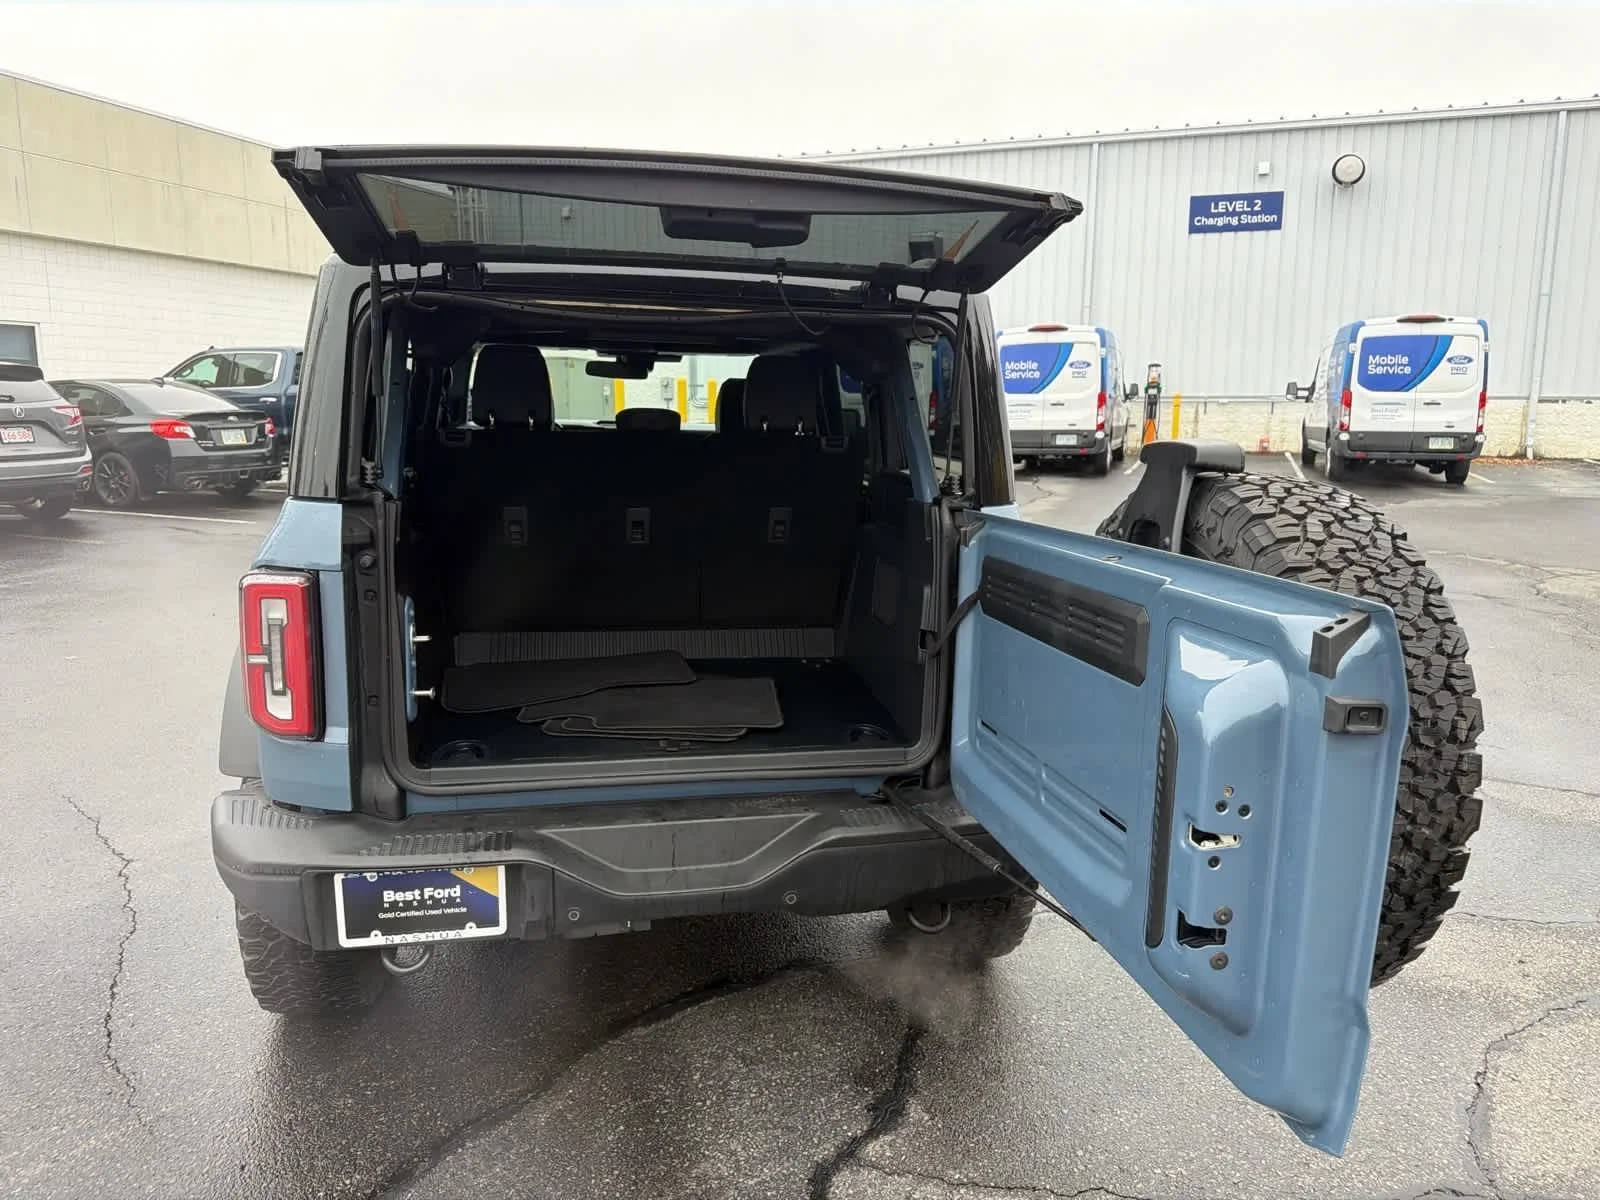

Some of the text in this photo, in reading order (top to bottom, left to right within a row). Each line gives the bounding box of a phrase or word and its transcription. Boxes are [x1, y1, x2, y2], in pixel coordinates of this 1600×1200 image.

[1211, 199, 1262, 213] LEVEL 2
[1194, 213, 1277, 227] Charging Station
[1005, 360, 1039, 371] Mobile
[1368, 354, 1409, 365] Mobile
[1005, 370, 1040, 380] Service
[1368, 364, 1412, 375] Service
[383, 885, 461, 902] Best Ford
[395, 910, 424, 918] Certified
[442, 906, 468, 914] Vehicle
[385, 931, 463, 944] NASHUA
